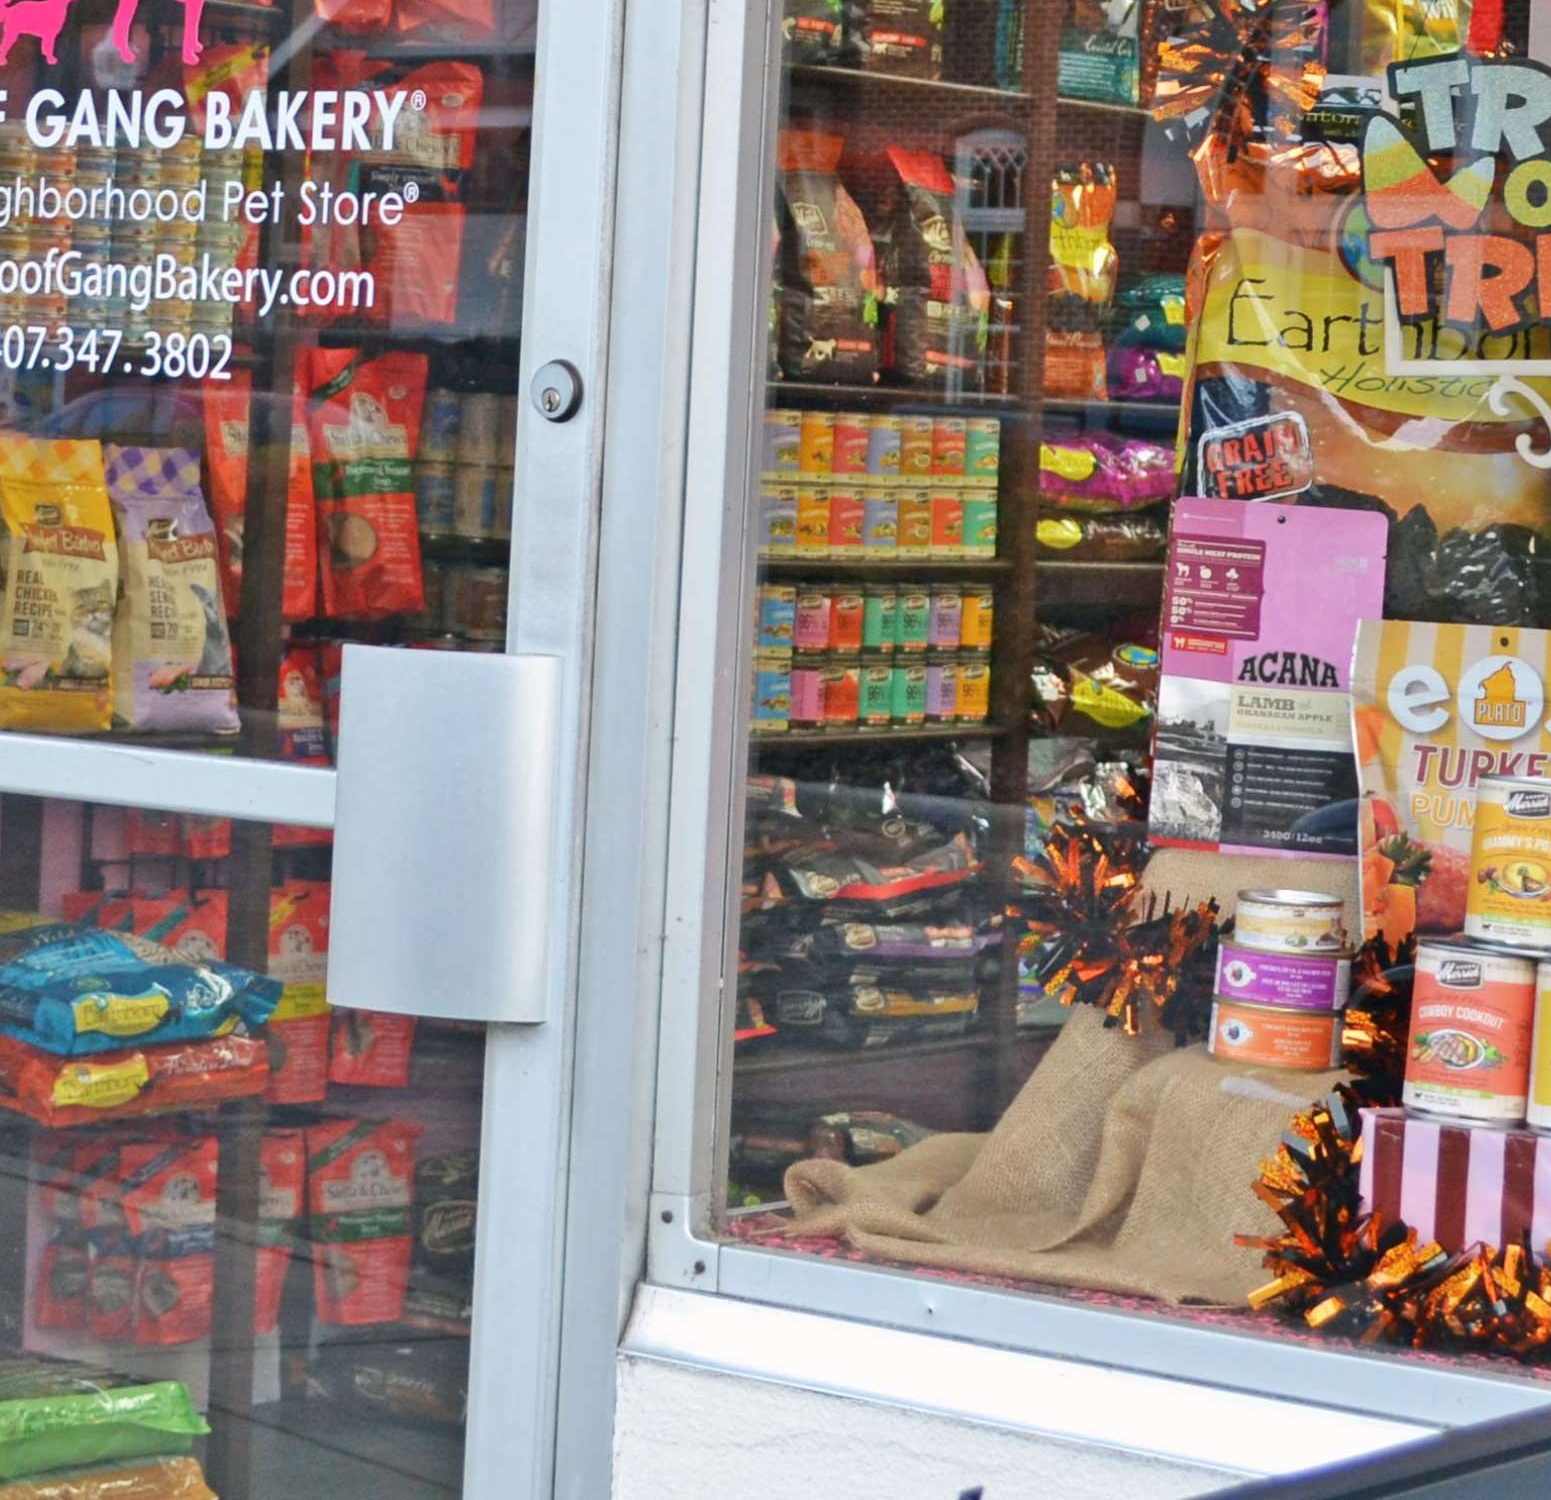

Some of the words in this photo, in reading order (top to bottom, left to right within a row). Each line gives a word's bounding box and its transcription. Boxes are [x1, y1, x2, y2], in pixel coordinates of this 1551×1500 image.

[25, 90, 186, 149] GANG
[222, 182, 284, 222] Pet
[1206, 424, 1299, 474] GRAIN
[1215, 460, 1295, 500] FREE
[1238, 651, 1340, 688] ACANA
[1237, 695, 1295, 712] LAMB
[1478, 705, 1522, 723] PLATO
